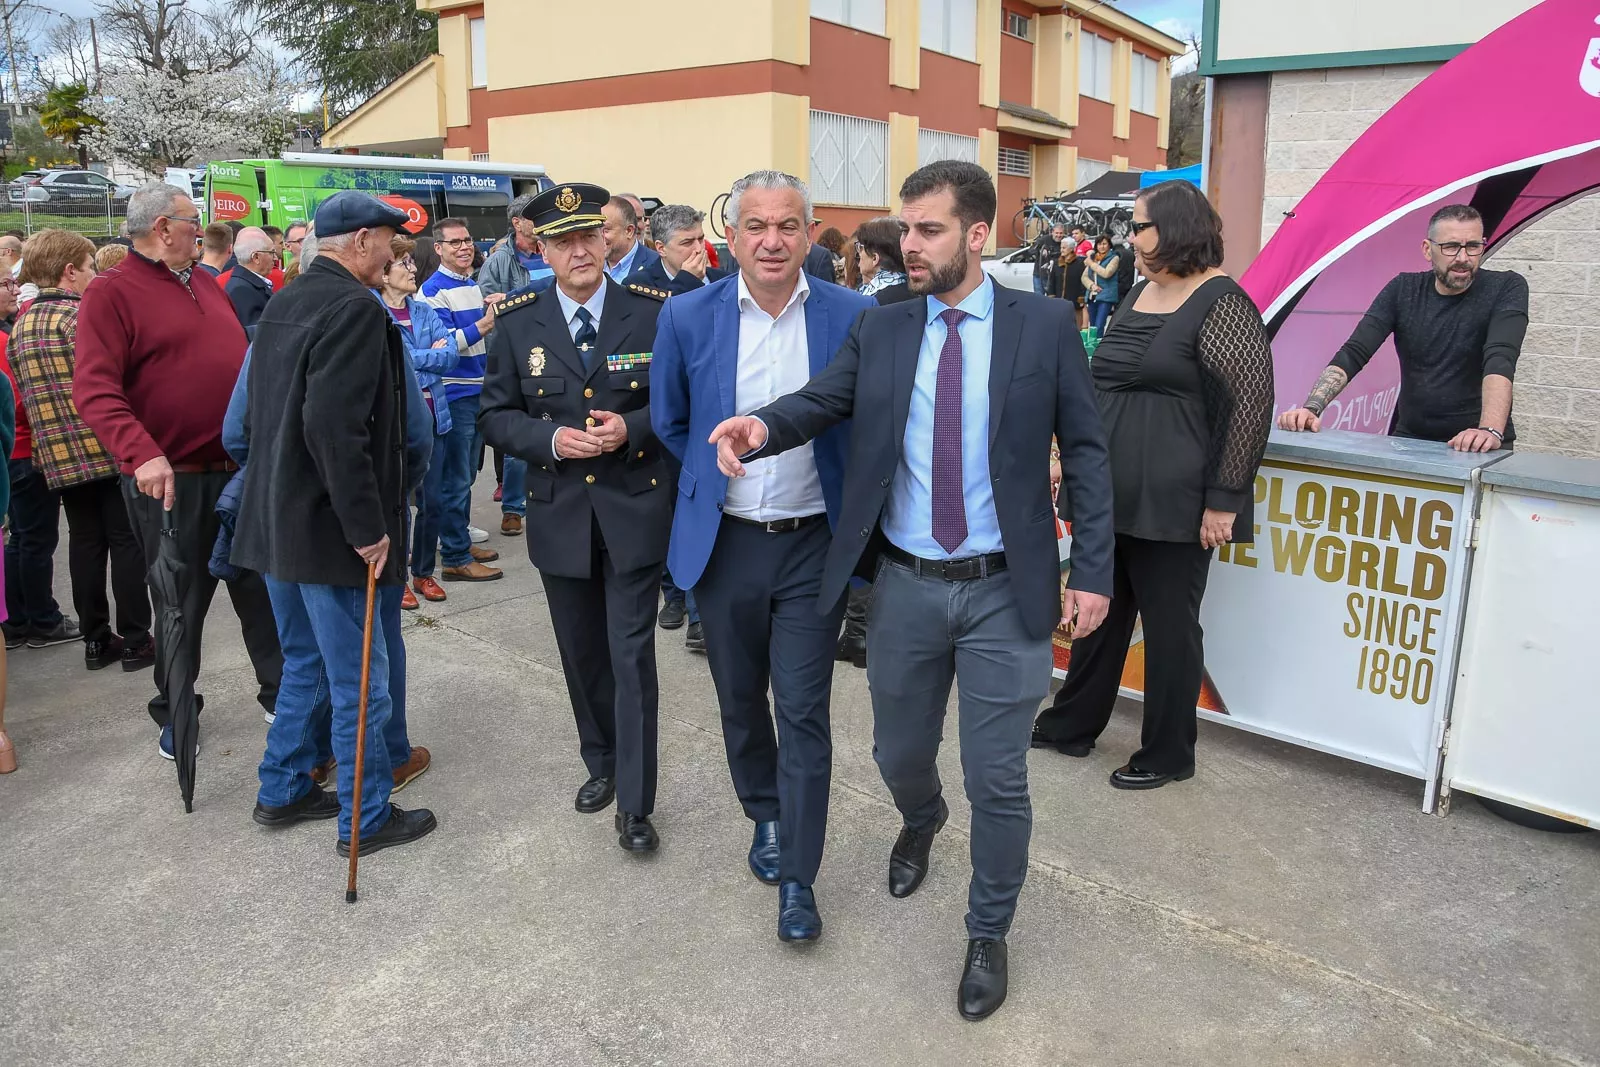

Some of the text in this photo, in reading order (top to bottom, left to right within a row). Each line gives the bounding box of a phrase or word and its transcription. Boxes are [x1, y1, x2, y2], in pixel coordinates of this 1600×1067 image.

[211, 164, 240, 177] Roriz
[451, 175, 469, 186] ACR
[470, 176, 497, 188] Roriz
[1254, 475, 1453, 551] PLORING
[1270, 526, 1447, 600] WORLD
[1343, 592, 1442, 655] SINCE
[1356, 646, 1434, 705] 1890
